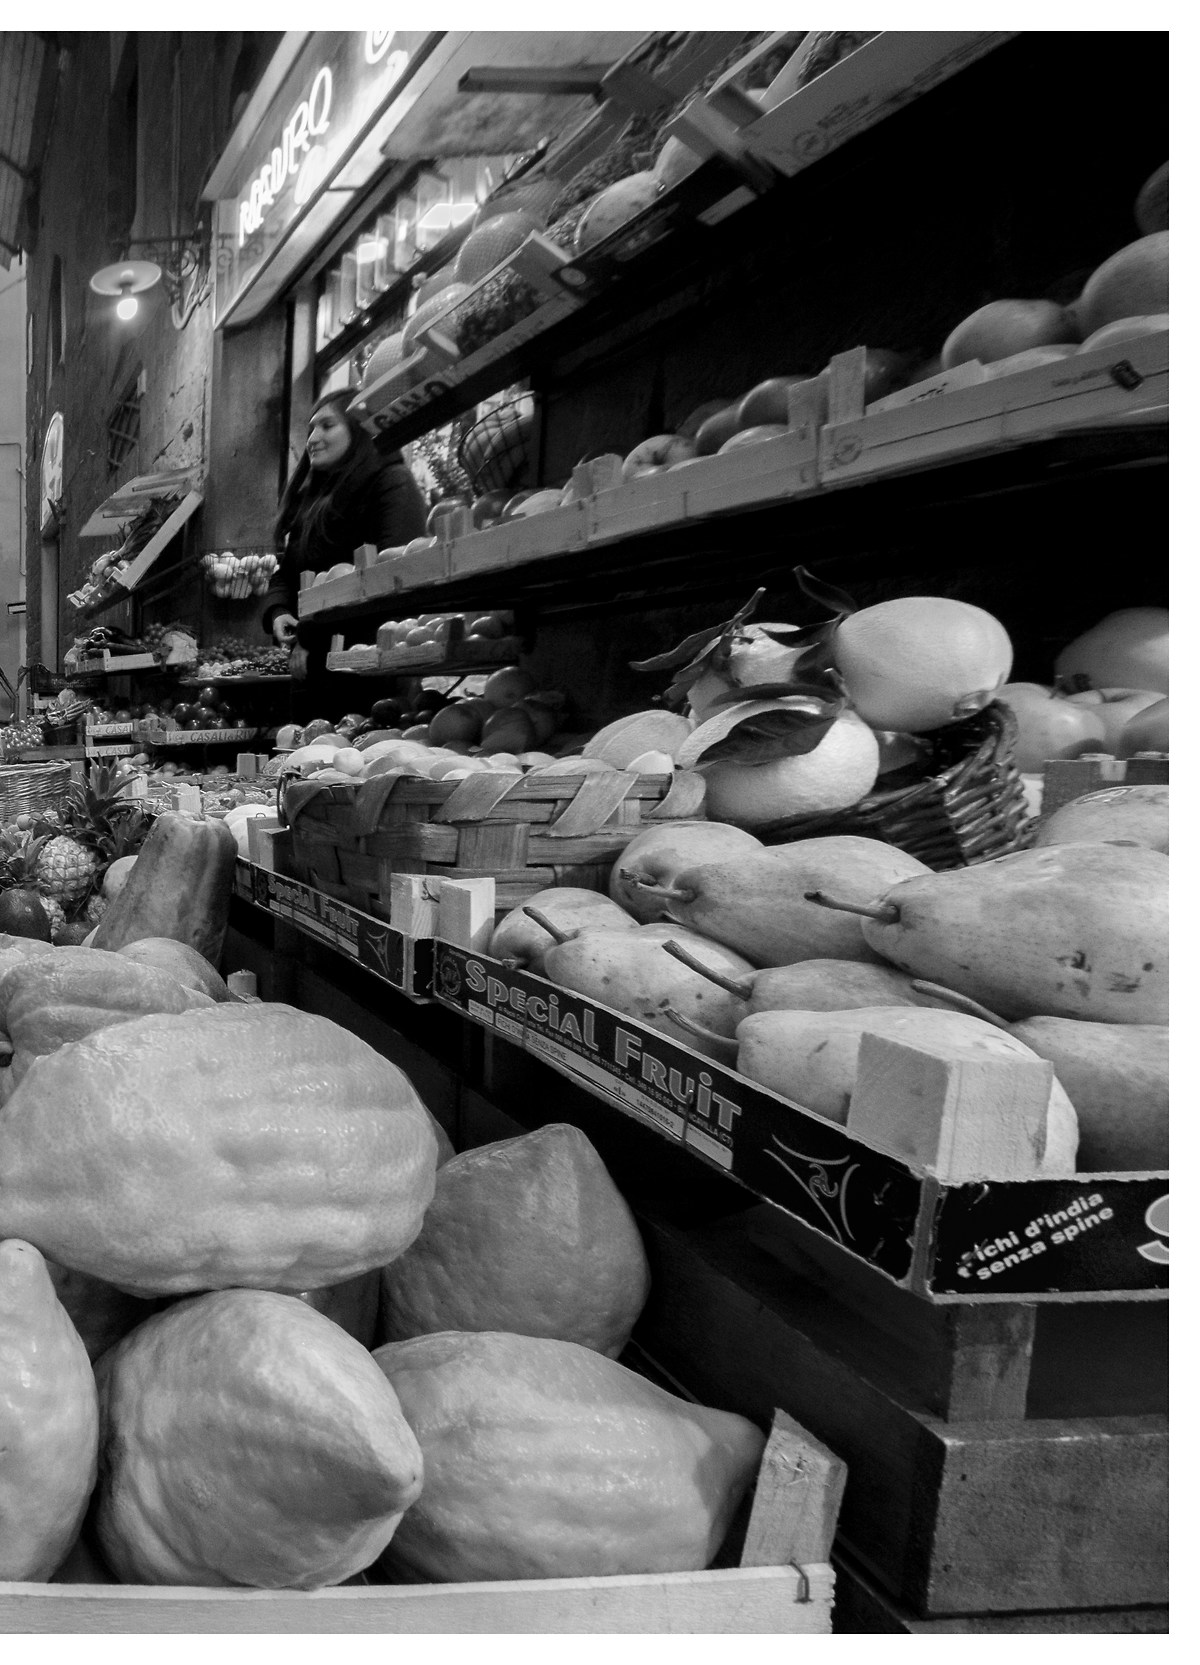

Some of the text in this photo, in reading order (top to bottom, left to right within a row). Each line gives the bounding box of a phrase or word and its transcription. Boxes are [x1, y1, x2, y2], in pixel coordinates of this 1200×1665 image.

[976, 1207, 1115, 1281] senza spine
[1024, 1193, 1104, 1238] d'india
